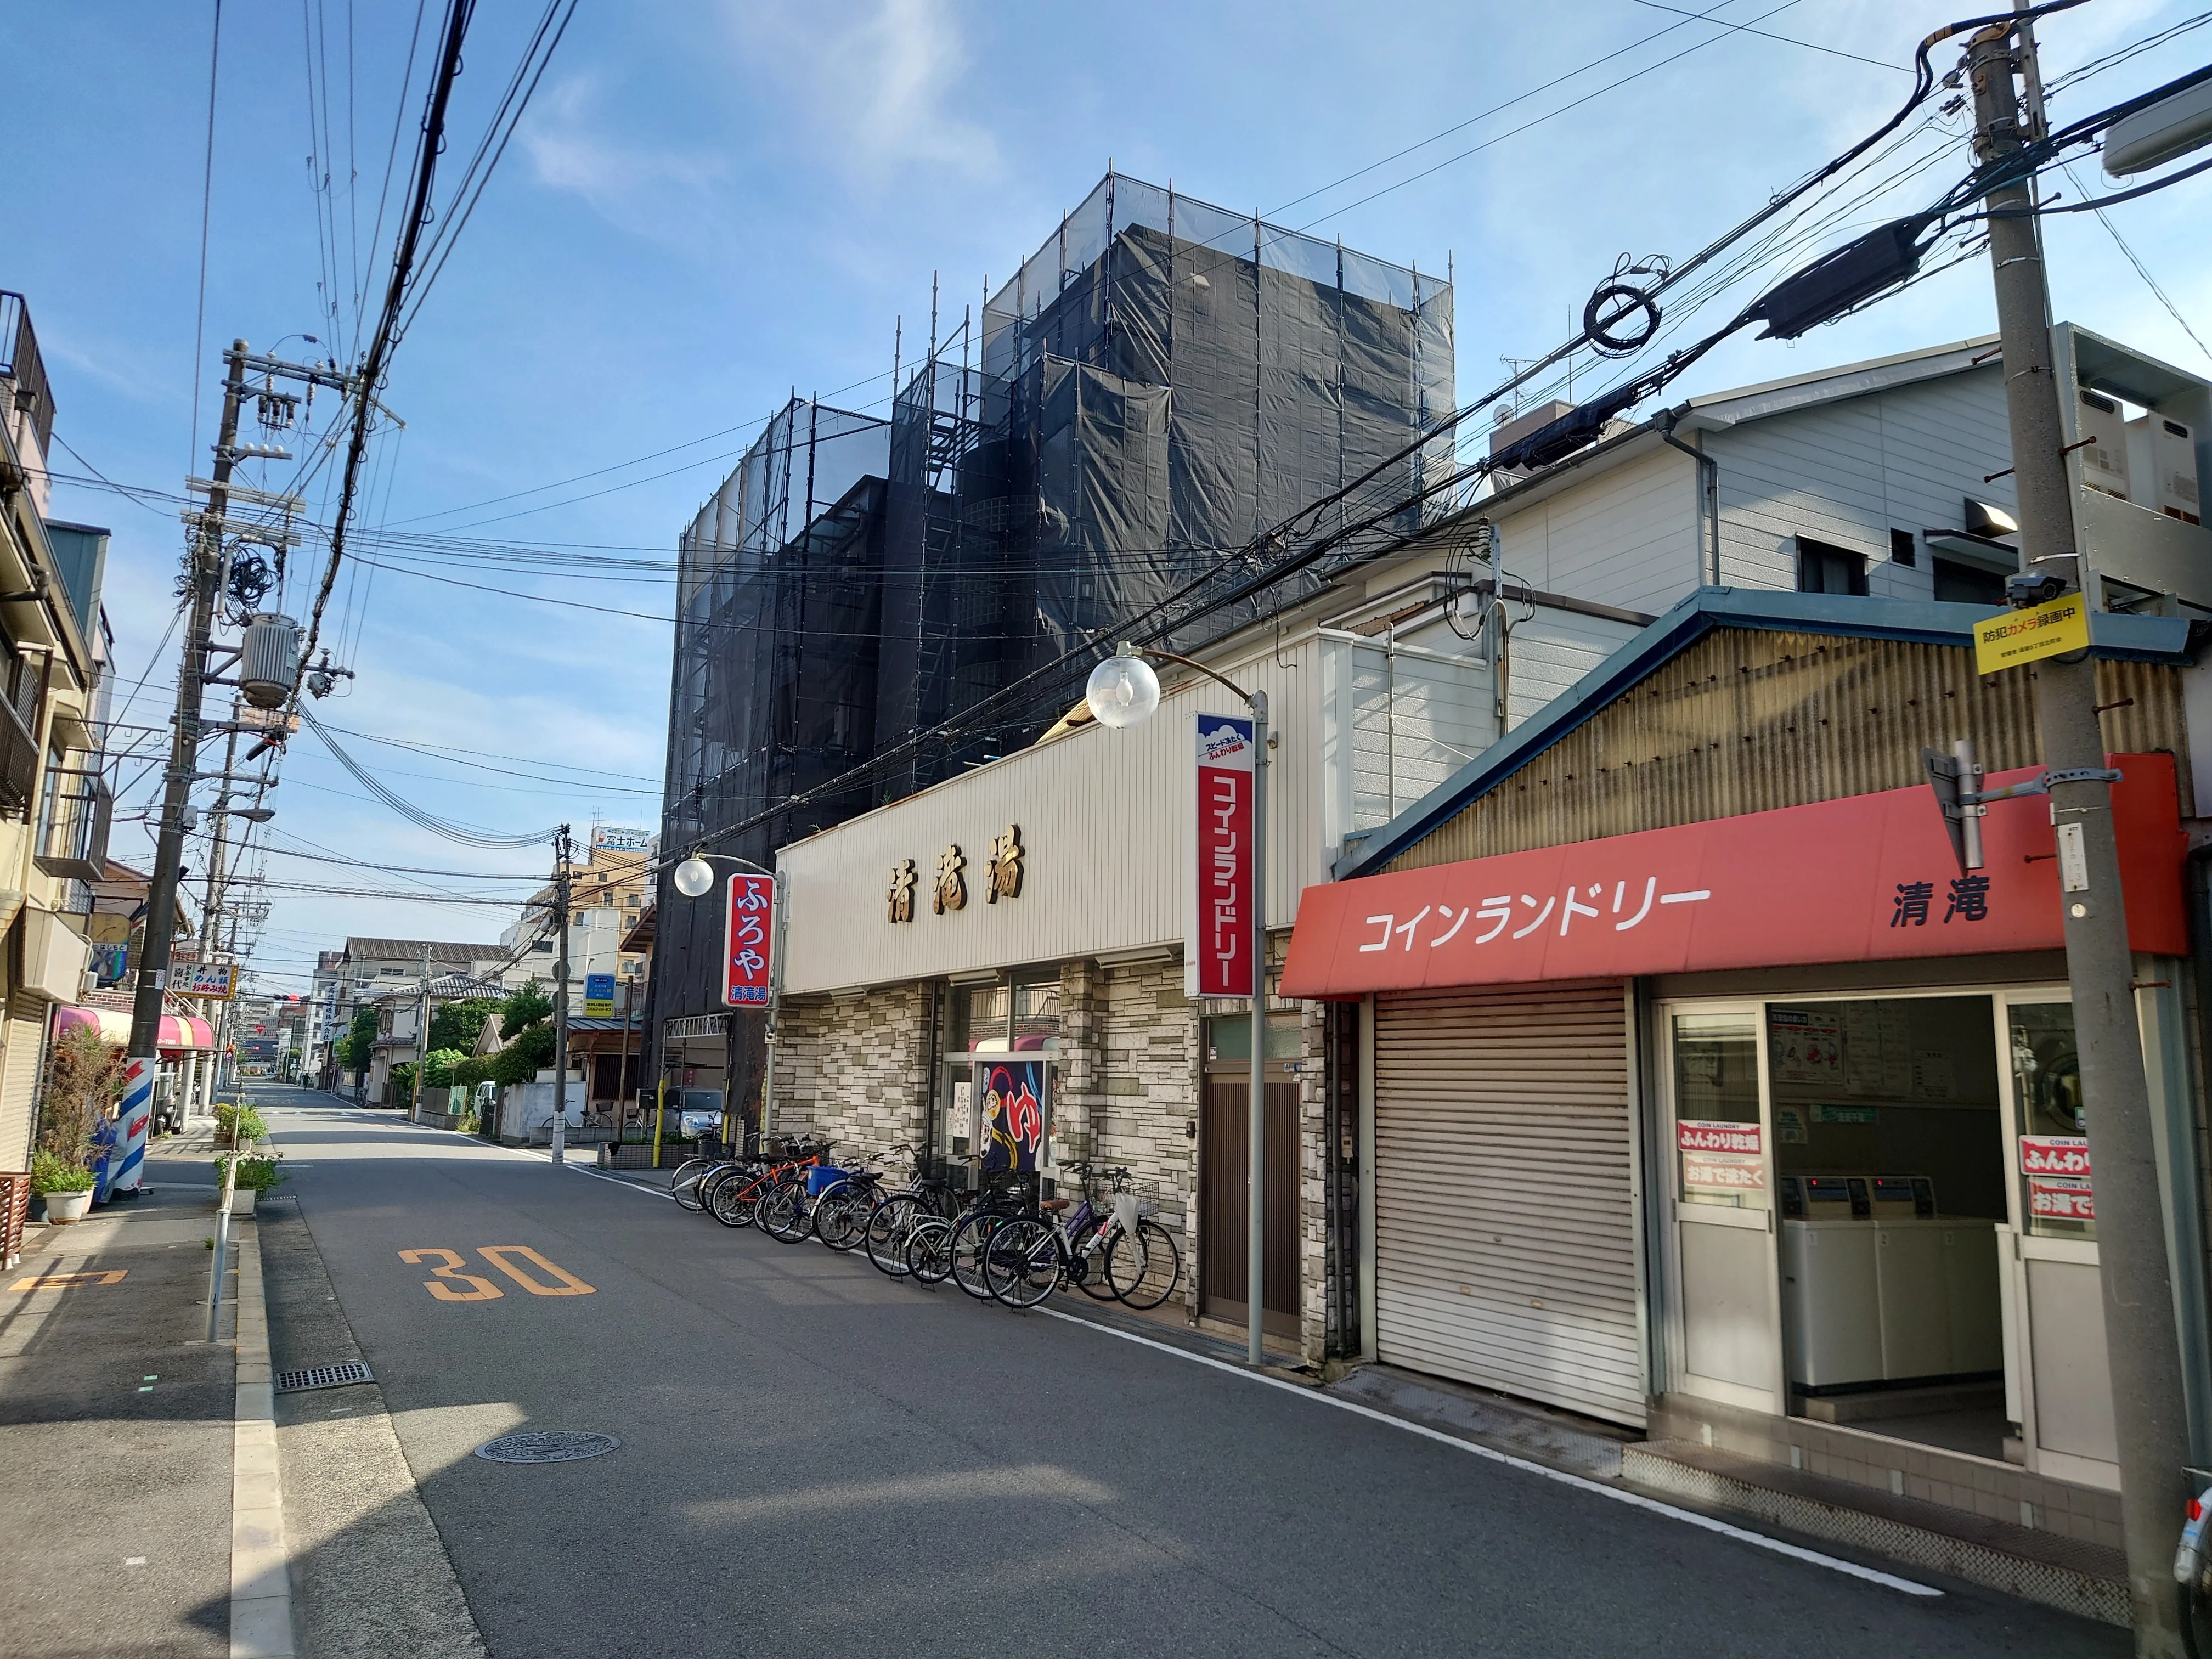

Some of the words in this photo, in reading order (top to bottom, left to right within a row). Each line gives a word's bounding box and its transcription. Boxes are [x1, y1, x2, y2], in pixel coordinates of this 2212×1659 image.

[1983, 607, 2075, 644] 防犯カメラ録画中
[1205, 733, 1242, 752] スピード洗たく
[1209, 742, 1245, 760] ふんわり乾燥
[607, 835, 648, 848] 富士ホーム
[1213, 776, 1237, 986] コインランドリー
[1890, 875, 1990, 927] 清滝
[1359, 876, 1711, 953] コインランドリー
[733, 878, 768, 981] ふろや
[192, 983, 228, 994] お好み焼
[194, 974, 228, 985] めん類
[730, 986, 767, 1000] 清滝湯
[1007, 1082, 1040, 1154] ゆ
[1681, 1131, 1759, 1151] ふんわり乾燥
[1687, 1165, 1763, 1186] お湯で洗たく
[2033, 1192, 2095, 1215] お湯で
[397, 1245, 598, 1301] 30
